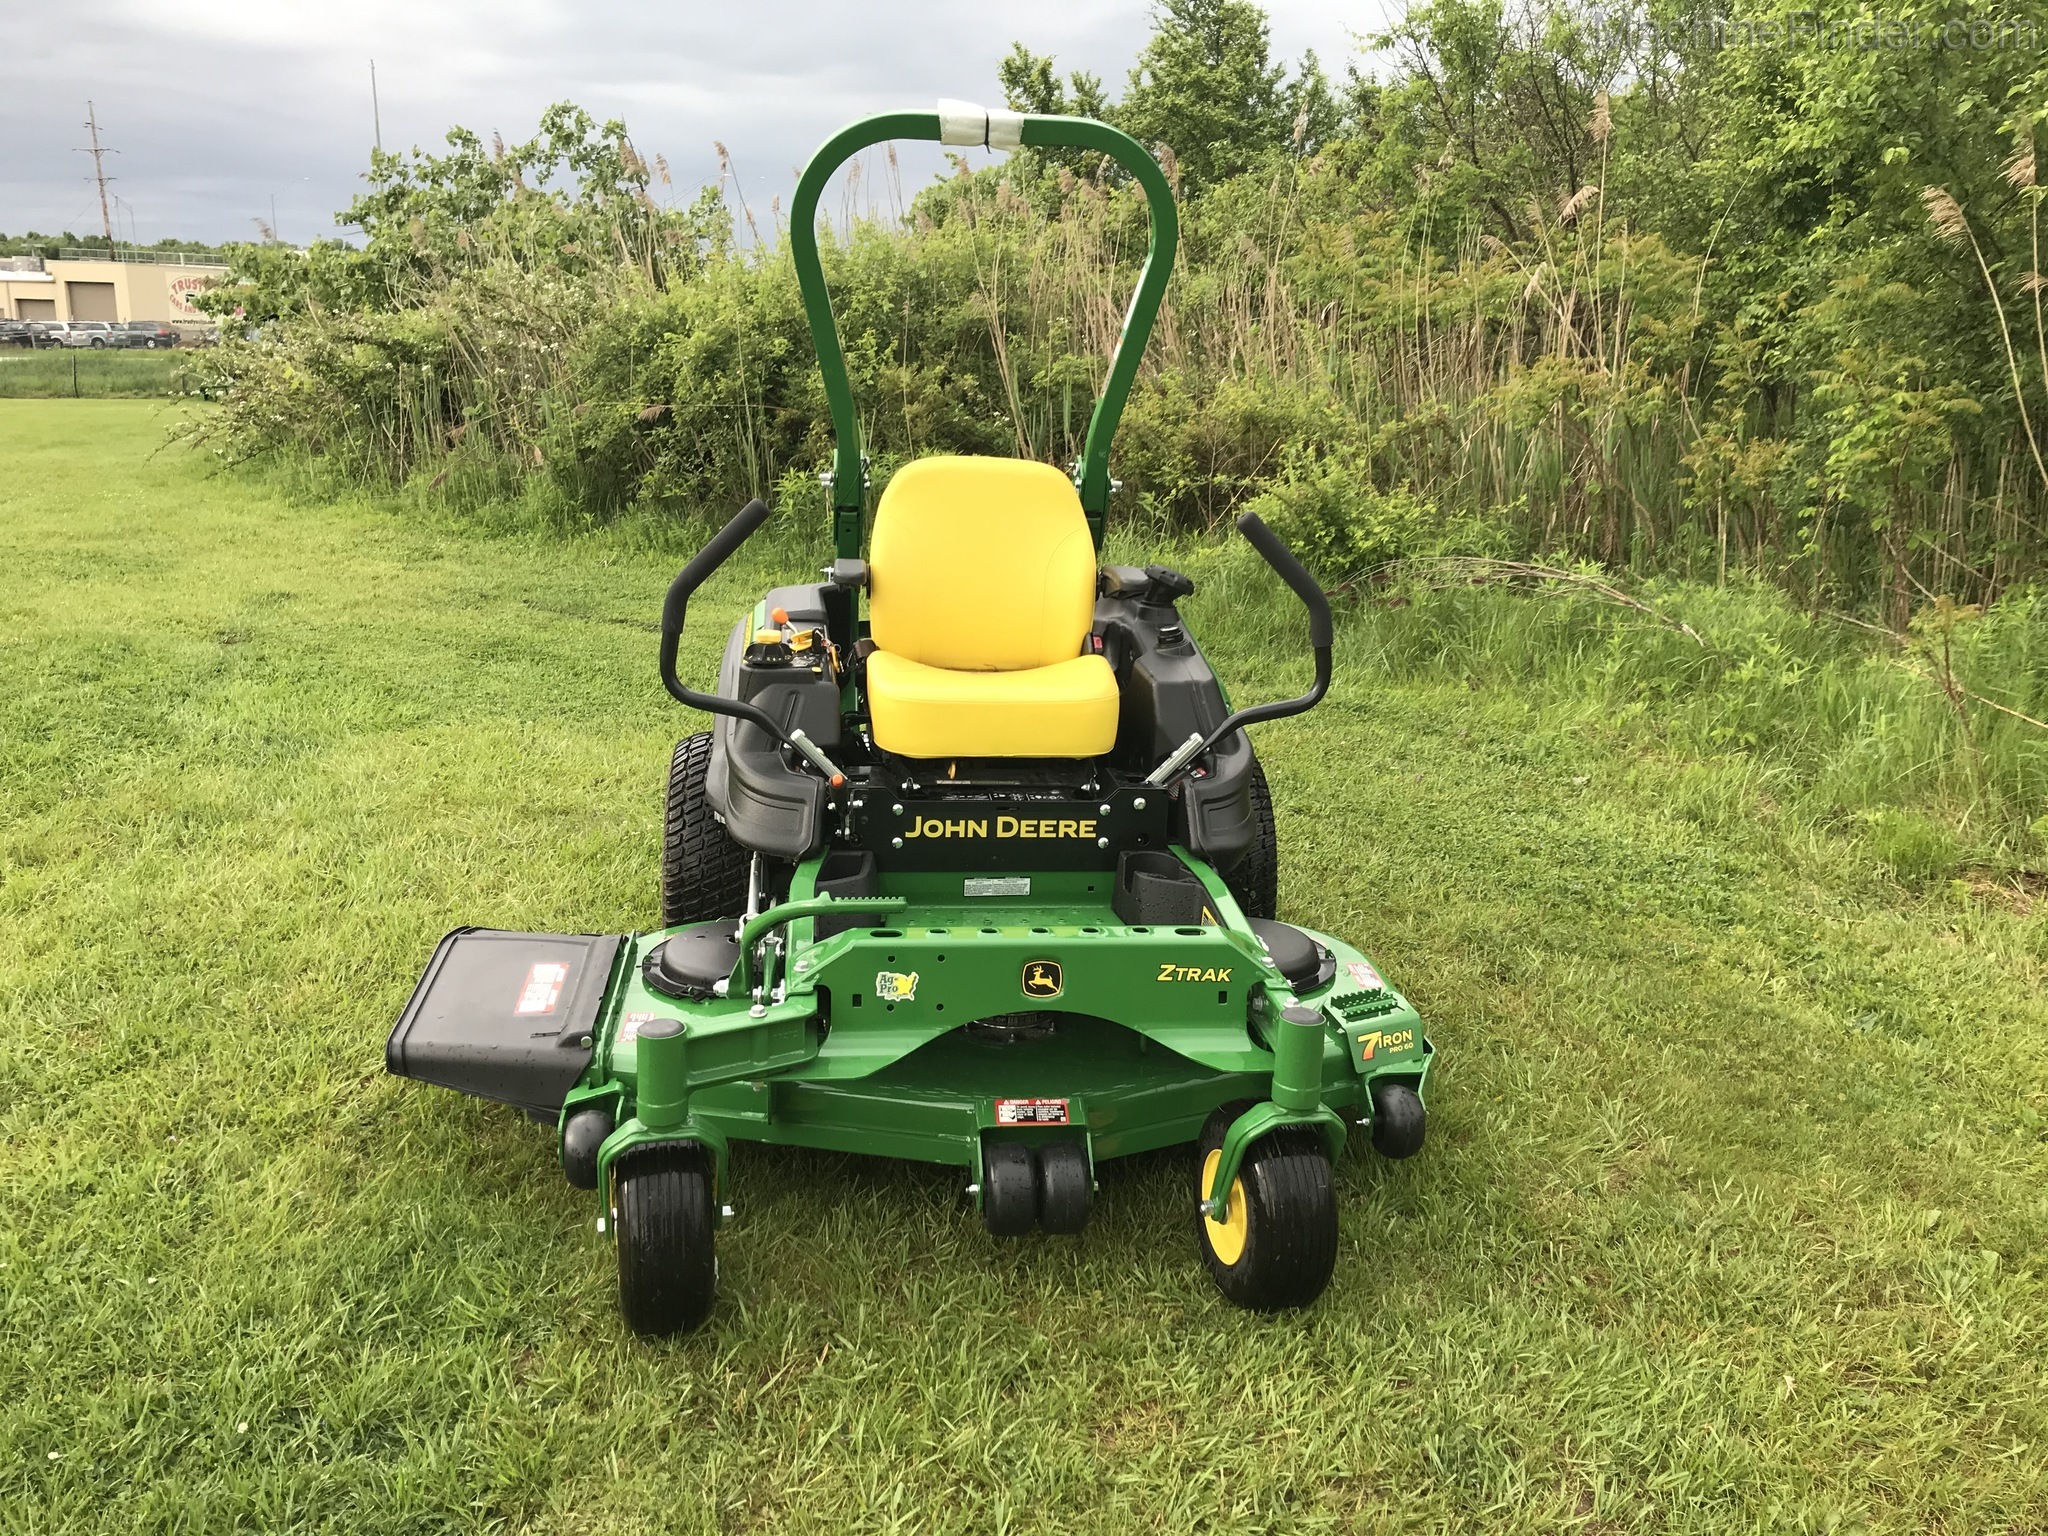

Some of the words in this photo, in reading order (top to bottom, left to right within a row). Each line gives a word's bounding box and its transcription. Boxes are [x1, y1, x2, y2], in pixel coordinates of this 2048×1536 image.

[171, 277, 204, 295] TRUST
[905, 816, 988, 838] JOHN
[996, 816, 1097, 838] DEERE
[1157, 964, 1233, 982] ZTRAK
[880, 984, 898, 993] Pro
[1389, 1045, 1403, 1054] PRO
[1404, 1042, 1414, 1050] 60
